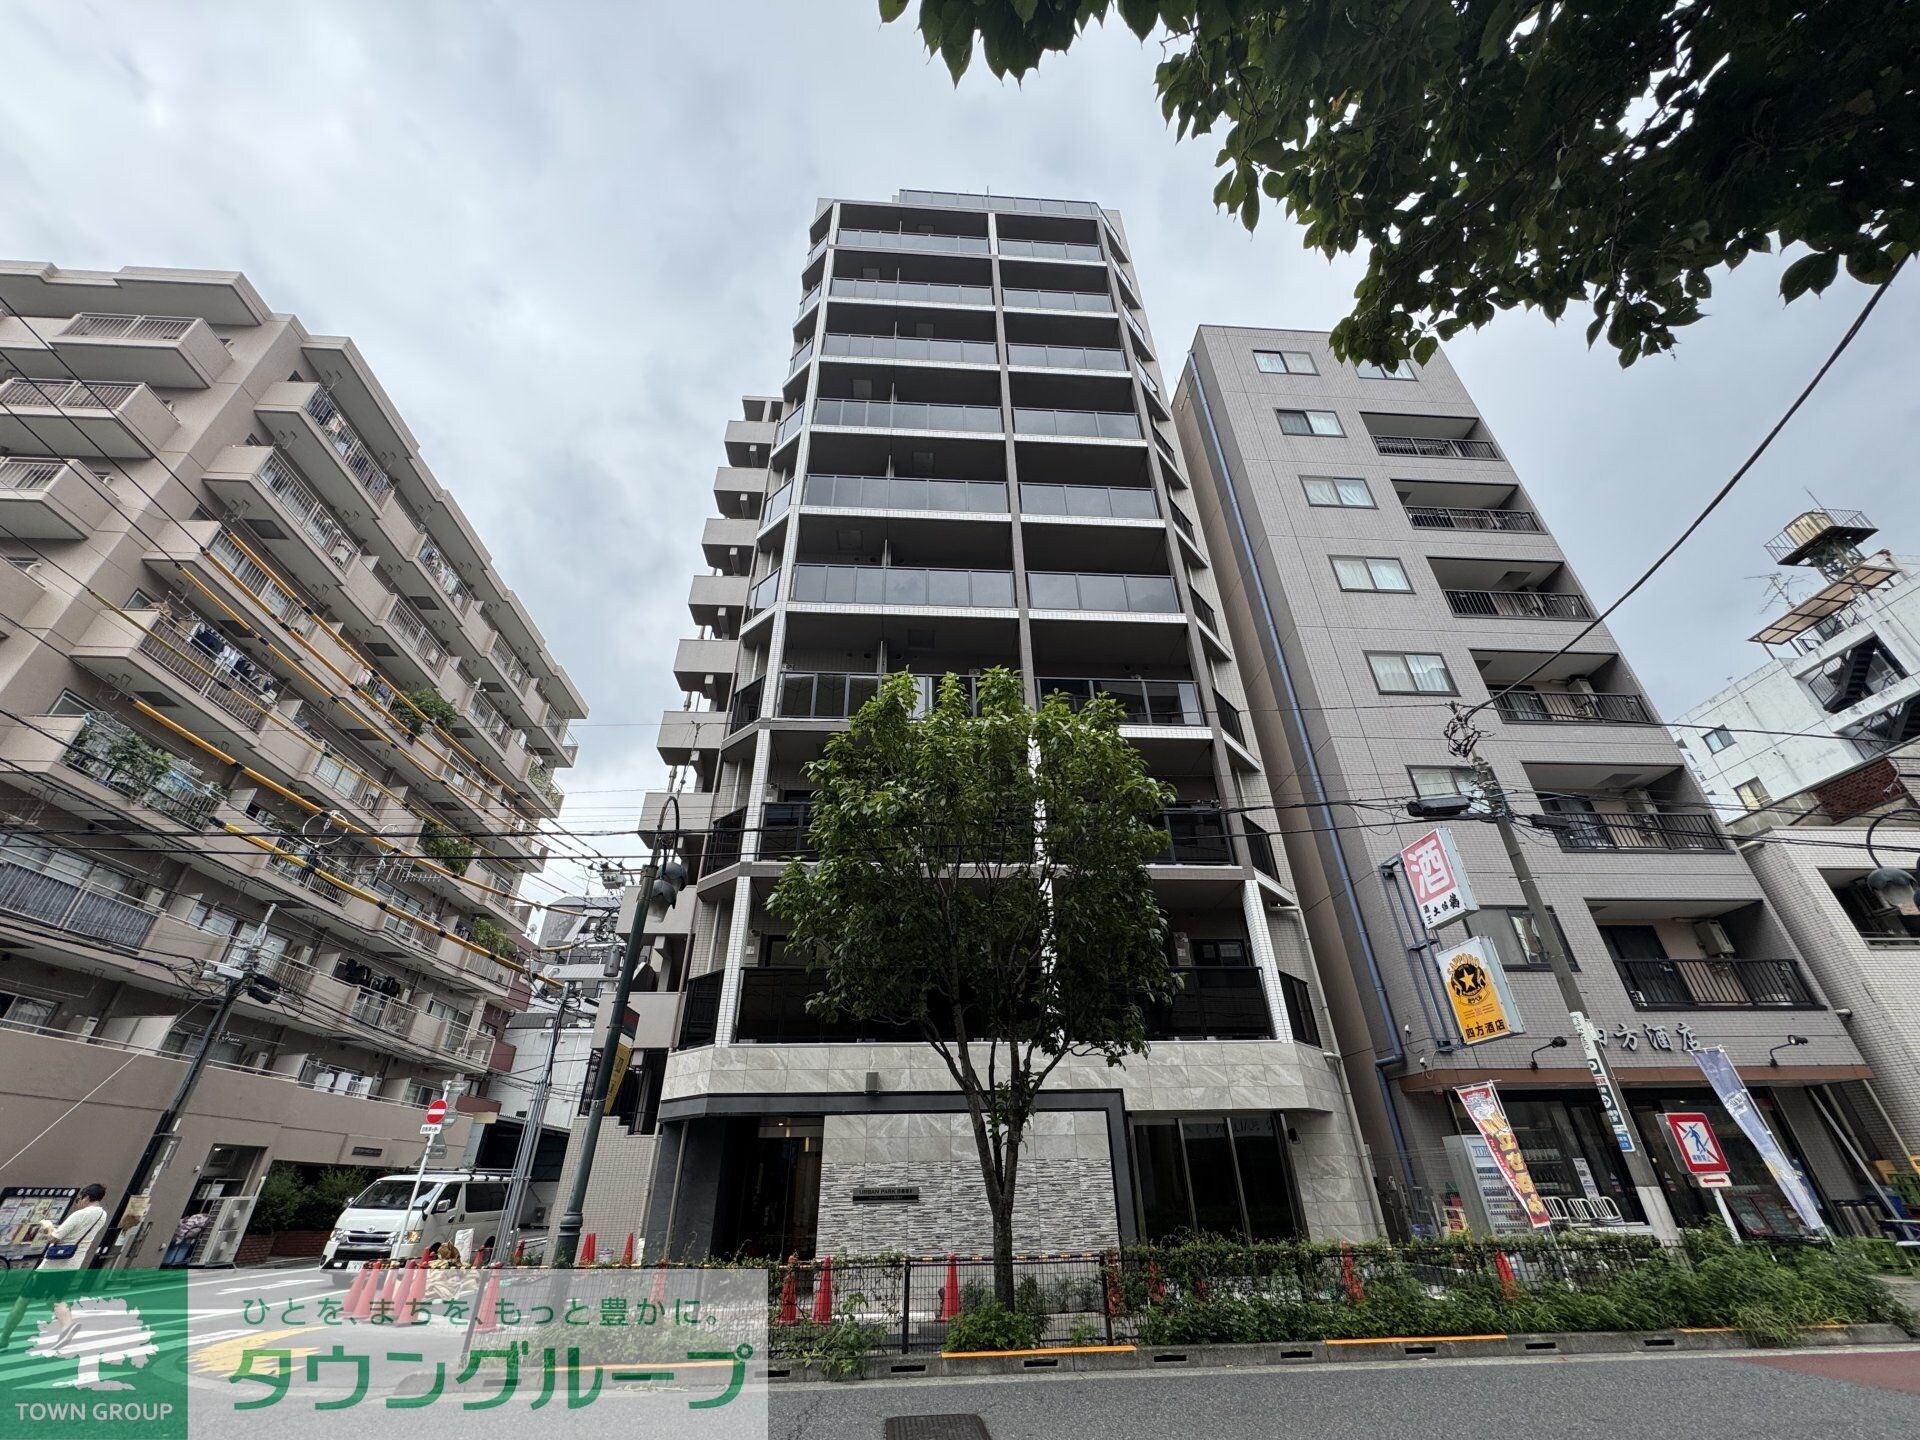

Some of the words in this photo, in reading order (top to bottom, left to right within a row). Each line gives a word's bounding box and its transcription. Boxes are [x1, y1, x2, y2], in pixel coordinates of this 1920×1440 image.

[1408, 839, 1450, 898] 酒
[1446, 952, 1480, 976] SAPPORO
[1465, 1018, 1506, 1039] 四方酒店
